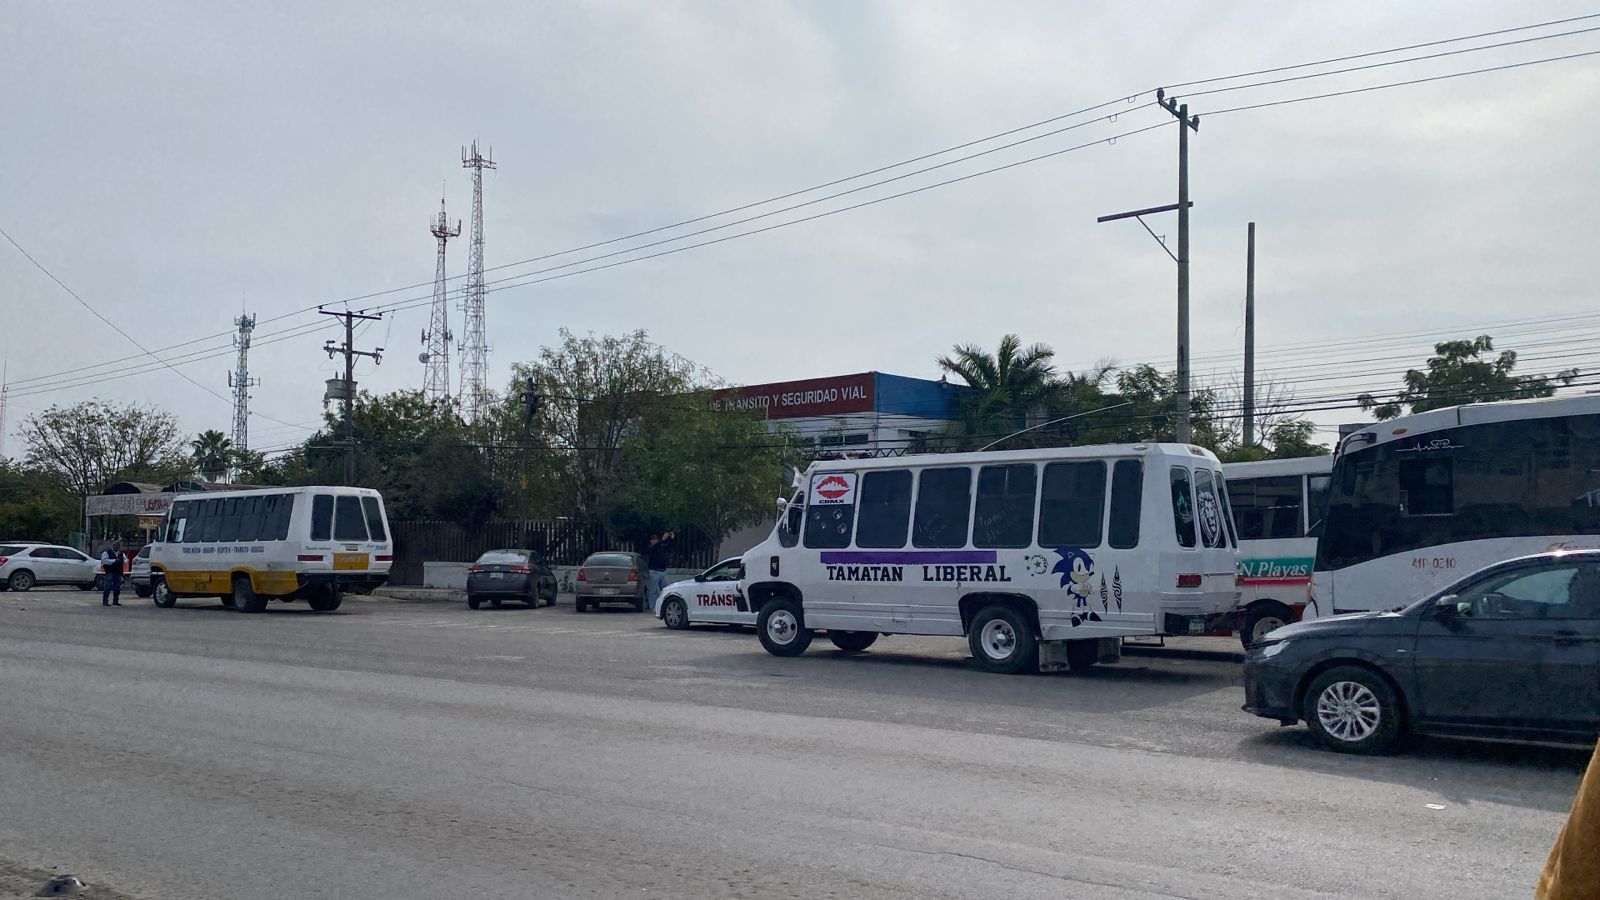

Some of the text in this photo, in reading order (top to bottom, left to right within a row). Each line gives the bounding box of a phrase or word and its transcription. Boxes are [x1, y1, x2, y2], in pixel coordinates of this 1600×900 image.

[772, 394, 779, 407] Y
[781, 388, 838, 406] SEGURIDAD
[841, 385, 867, 400] VIAL
[826, 565, 1012, 582] TAMATAN LIBERAL
[1257, 561, 1308, 579] Playas
